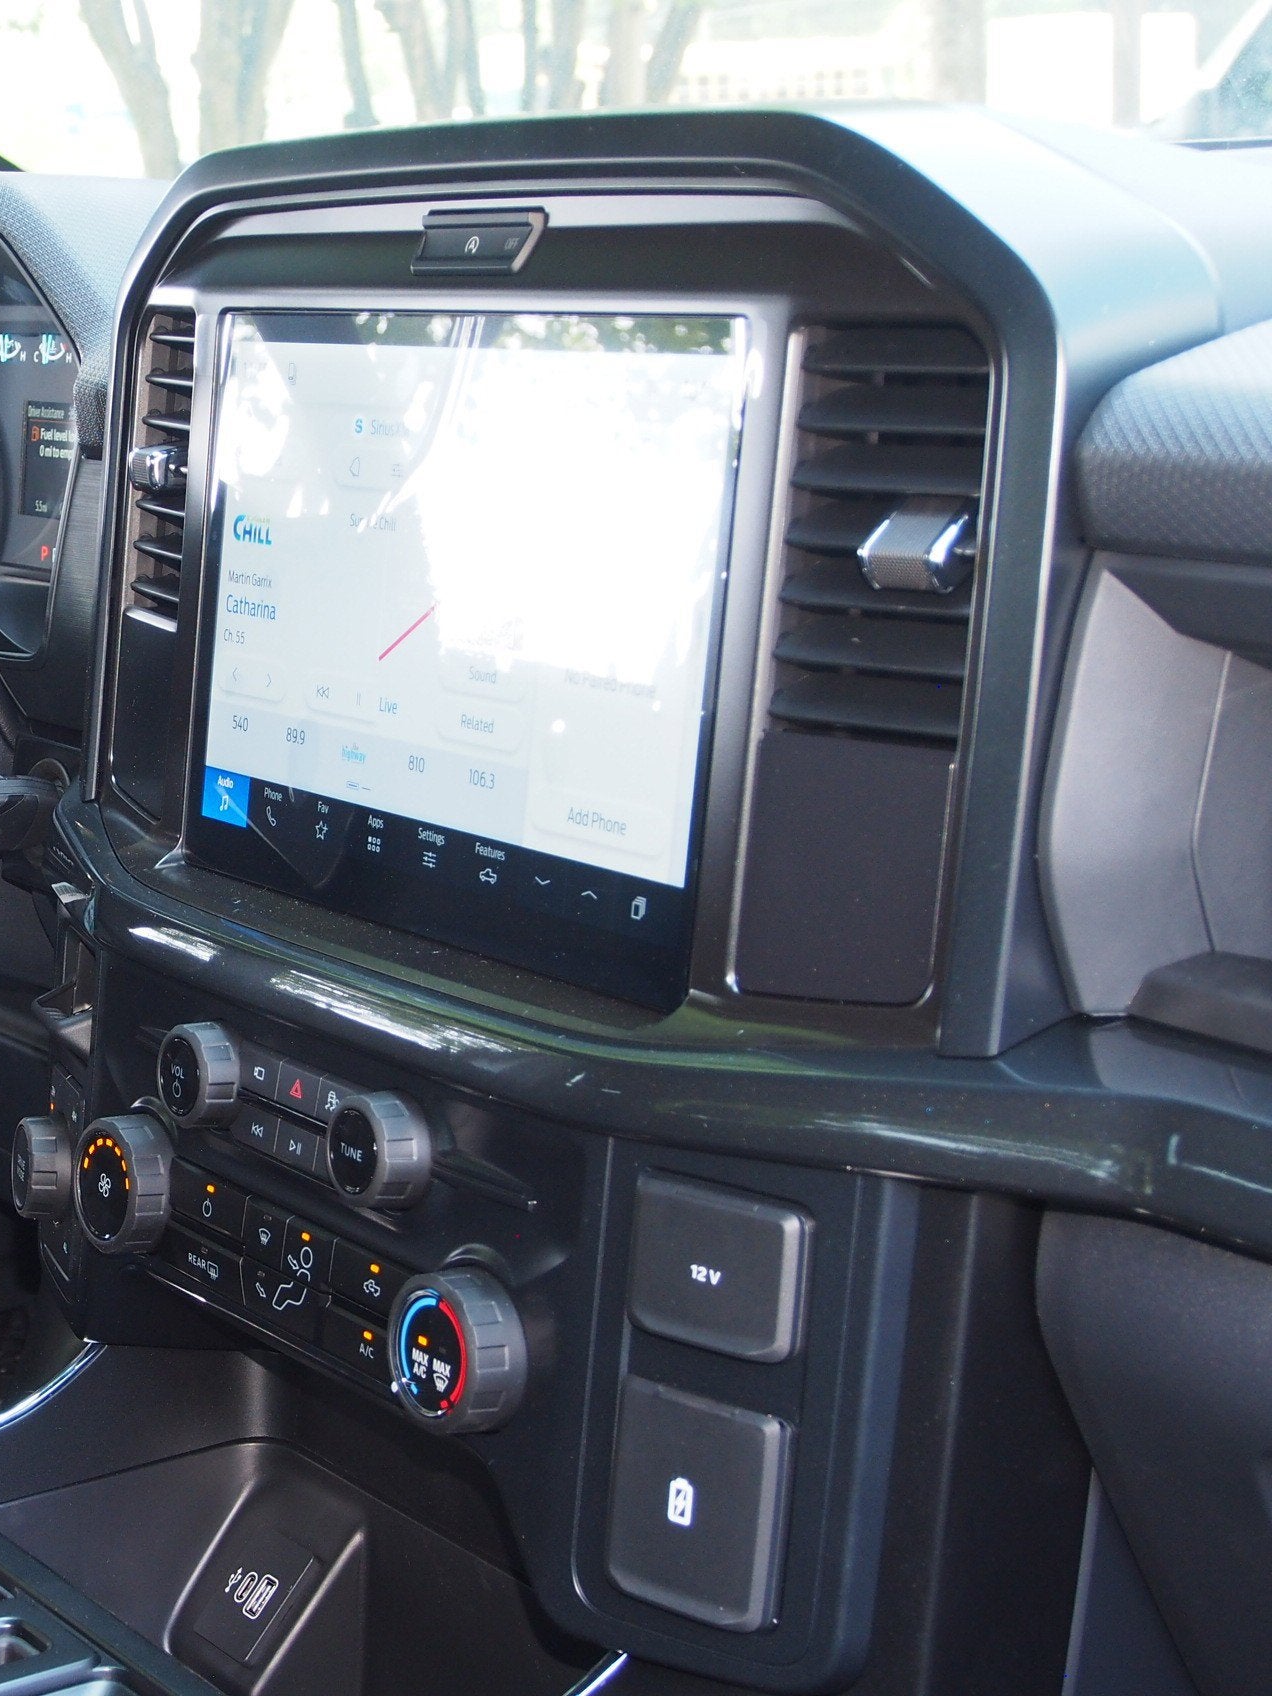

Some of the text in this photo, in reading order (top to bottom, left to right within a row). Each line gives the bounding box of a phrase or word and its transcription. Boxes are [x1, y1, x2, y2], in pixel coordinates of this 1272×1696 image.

[504, 237, 520, 250] OFF
[20, 351, 26, 362] H
[33, 351, 39, 362] C
[65, 352, 72, 363] H
[40, 428, 53, 441] Fuel
[53, 429, 68, 442] level
[39, 445, 45, 457] 0
[45, 445, 53, 457] mi
[53, 446, 59, 458] to
[41, 545, 49, 561] P
[228, 569, 272, 588] Martin Garrix
[226, 594, 276, 620] Catharina
[235, 631, 245, 644] 55
[468, 665, 497, 684] Sound
[379, 697, 398, 715] Live
[232, 715, 249, 732] 540
[460, 713, 494, 734] Related
[286, 727, 305, 745] 89.9
[408, 755, 425, 773] 810
[217, 775, 234, 789] Audio
[469, 768, 495, 790] 106.3
[264, 787, 283, 802] Phone
[317, 801, 329, 814] Fav
[367, 814, 384, 829] Apps
[567, 806, 627, 837] Add Phone
[418, 827, 445, 846] Settings
[475, 842, 505, 861] Features
[170, 1065, 184, 1079] VOL
[340, 1142, 363, 1162] TUNE
[188, 1253, 206, 1270] REAR
[359, 1342, 374, 1359] A/C
[412, 1347, 429, 1367] MAX
[413, 1362, 427, 1379] A/C
[432, 1357, 451, 1378] MAX
